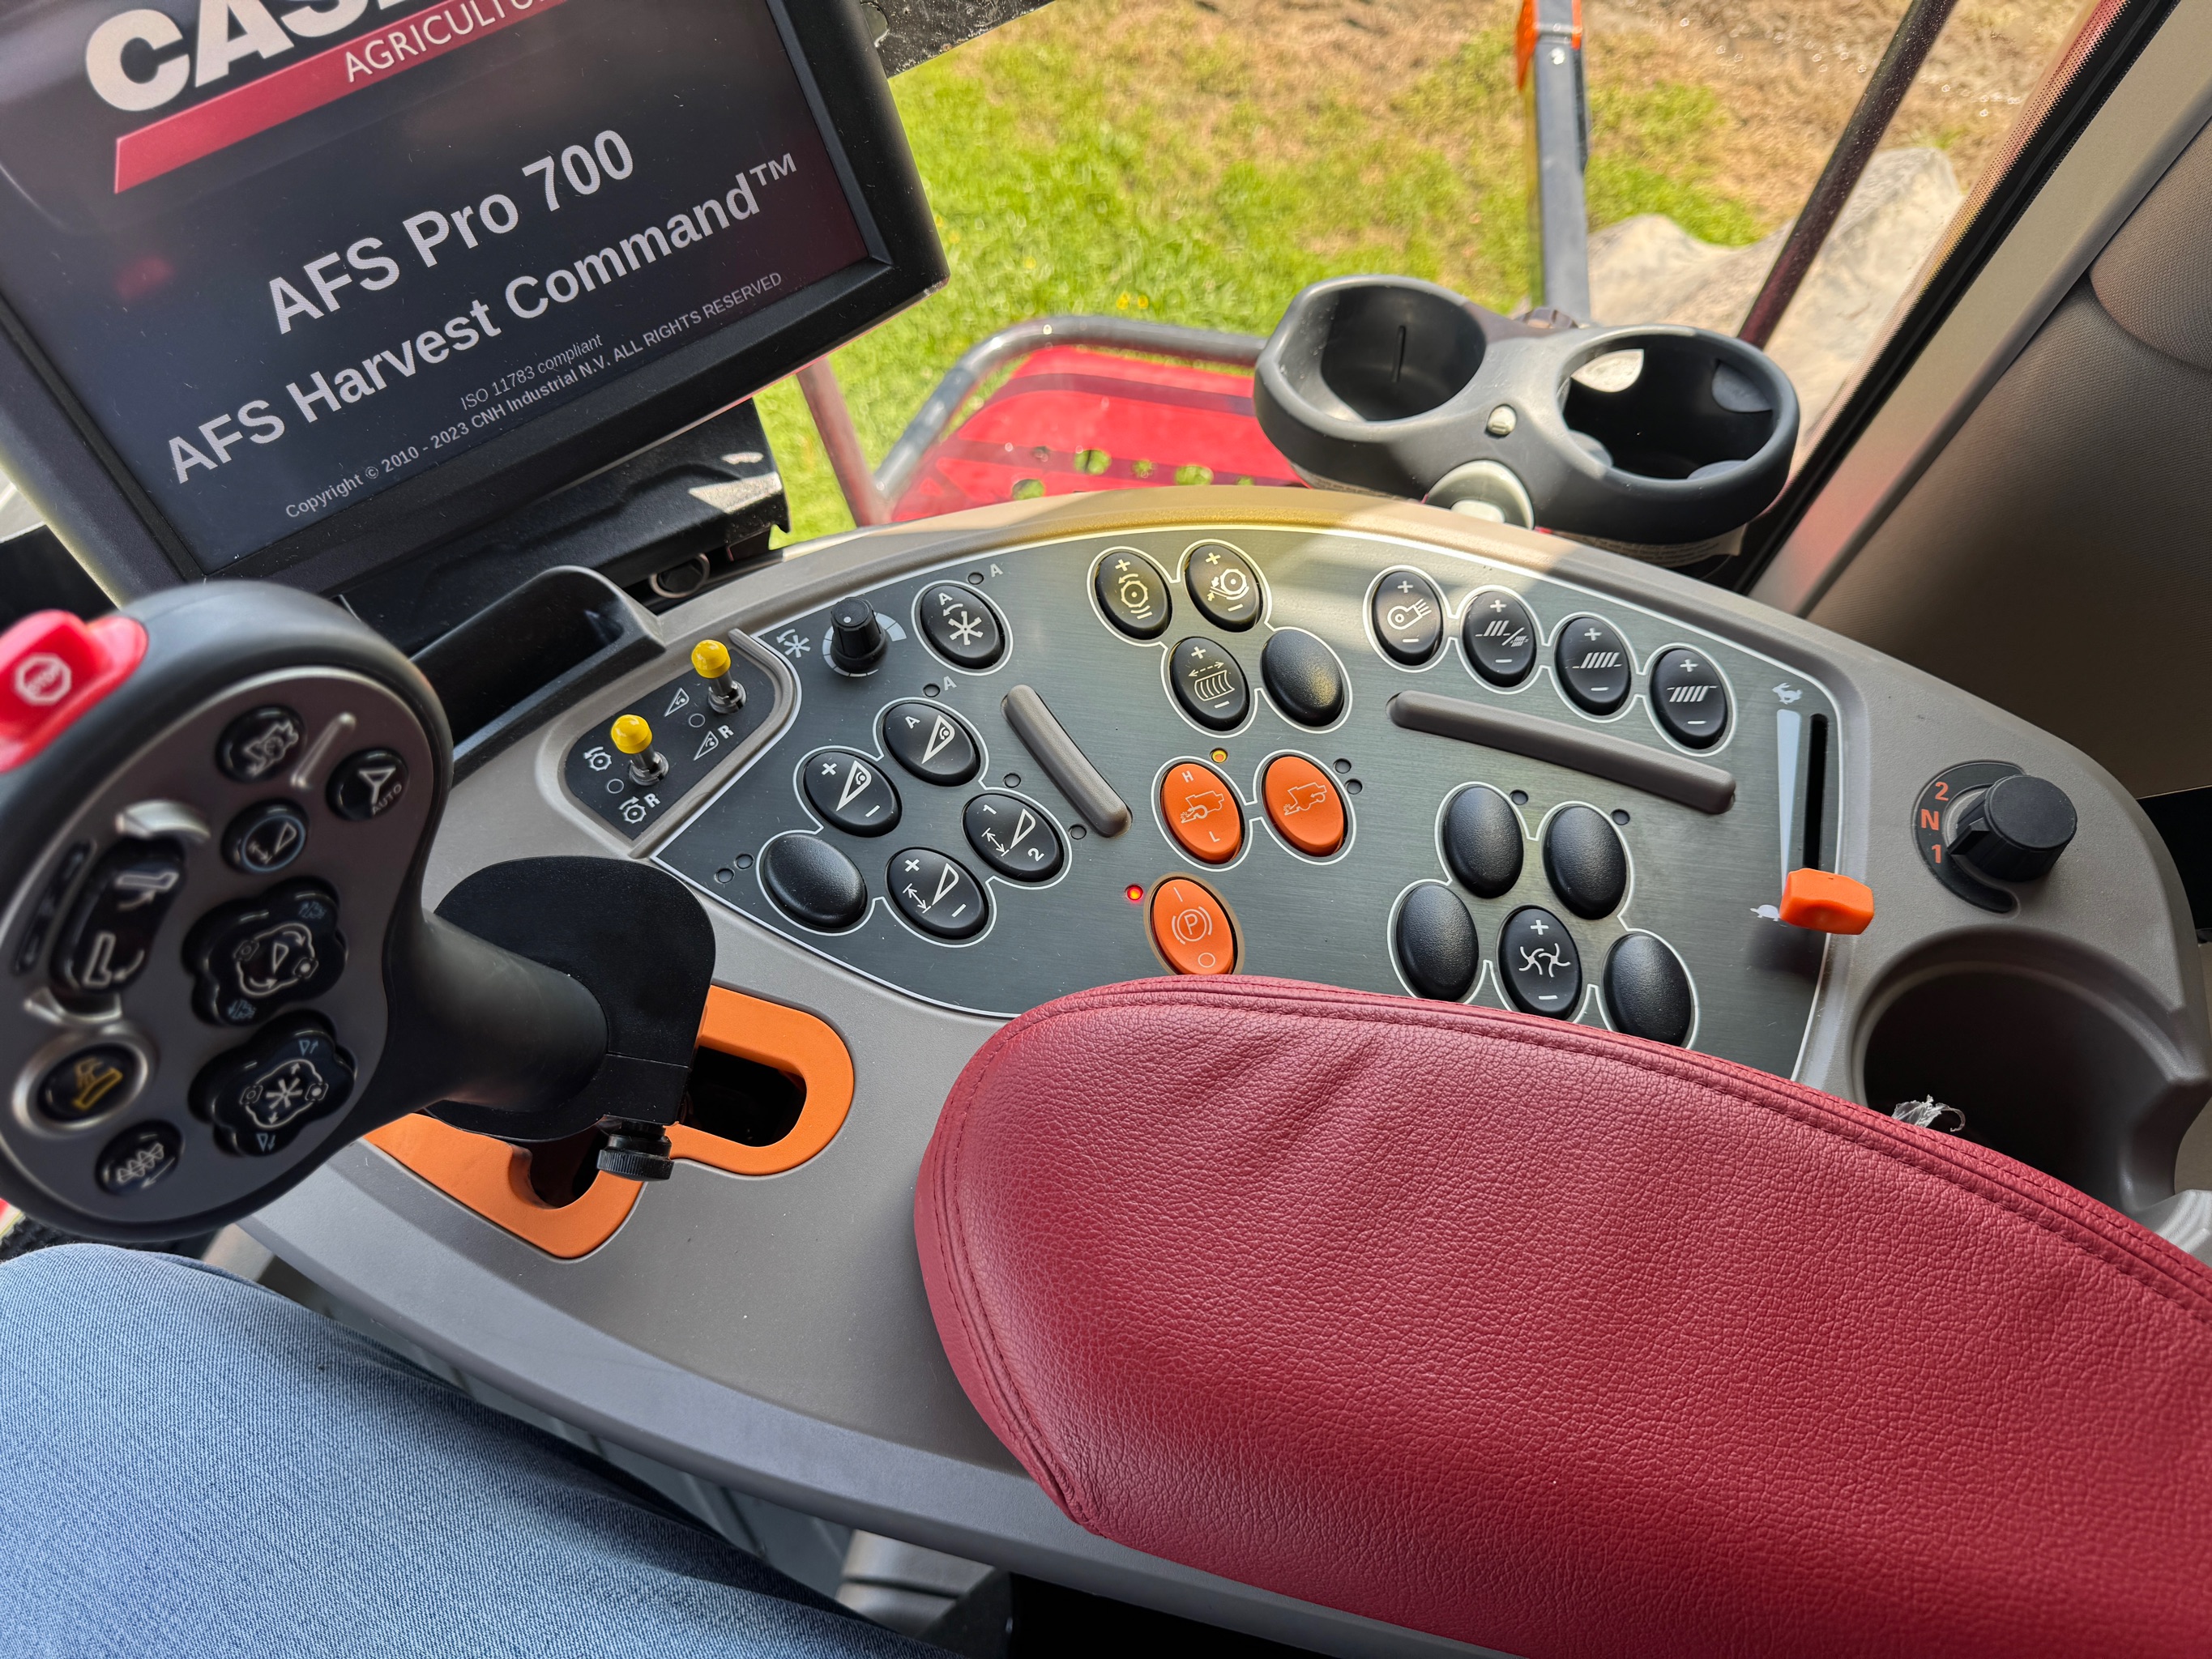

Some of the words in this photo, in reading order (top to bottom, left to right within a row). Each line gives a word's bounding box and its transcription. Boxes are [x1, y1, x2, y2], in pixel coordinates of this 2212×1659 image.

[268, 237, 400, 335] AFS
[402, 194, 519, 268] Pro
[521, 130, 634, 212] 700
[460, 388, 489, 411] ISO
[491, 366, 536, 397] 11783
[537, 333, 604, 374] compliant
[168, 399, 285, 484] AFS
[285, 299, 502, 424] Harvest
[285, 473, 365, 518] Copyright
[381, 446, 420, 473] 2010
[430, 422, 470, 449] 2023
[471, 403, 506, 429] CNH
[506, 369, 579, 412] Industrial
[579, 355, 612, 378] N.V.
[613, 340, 644, 363] ALL
[643, 310, 702, 348] RIGHTS
[702, 272, 782, 319] RESERVED
[989, 563, 1004, 578] A
[937, 592, 954, 606] A
[942, 676, 958, 691] A
[904, 715, 921, 729] A
[717, 724, 734, 740] R
[1181, 770, 1194, 783] H
[372, 783, 403, 816] AUTO
[1934, 781, 1949, 802] 2
[643, 792, 661, 808] R
[982, 804, 997, 815] 1
[1920, 808, 1940, 831] N
[1208, 830, 1221, 843] L
[1027, 847, 1045, 862] 2
[1931, 843, 1942, 864] 1
